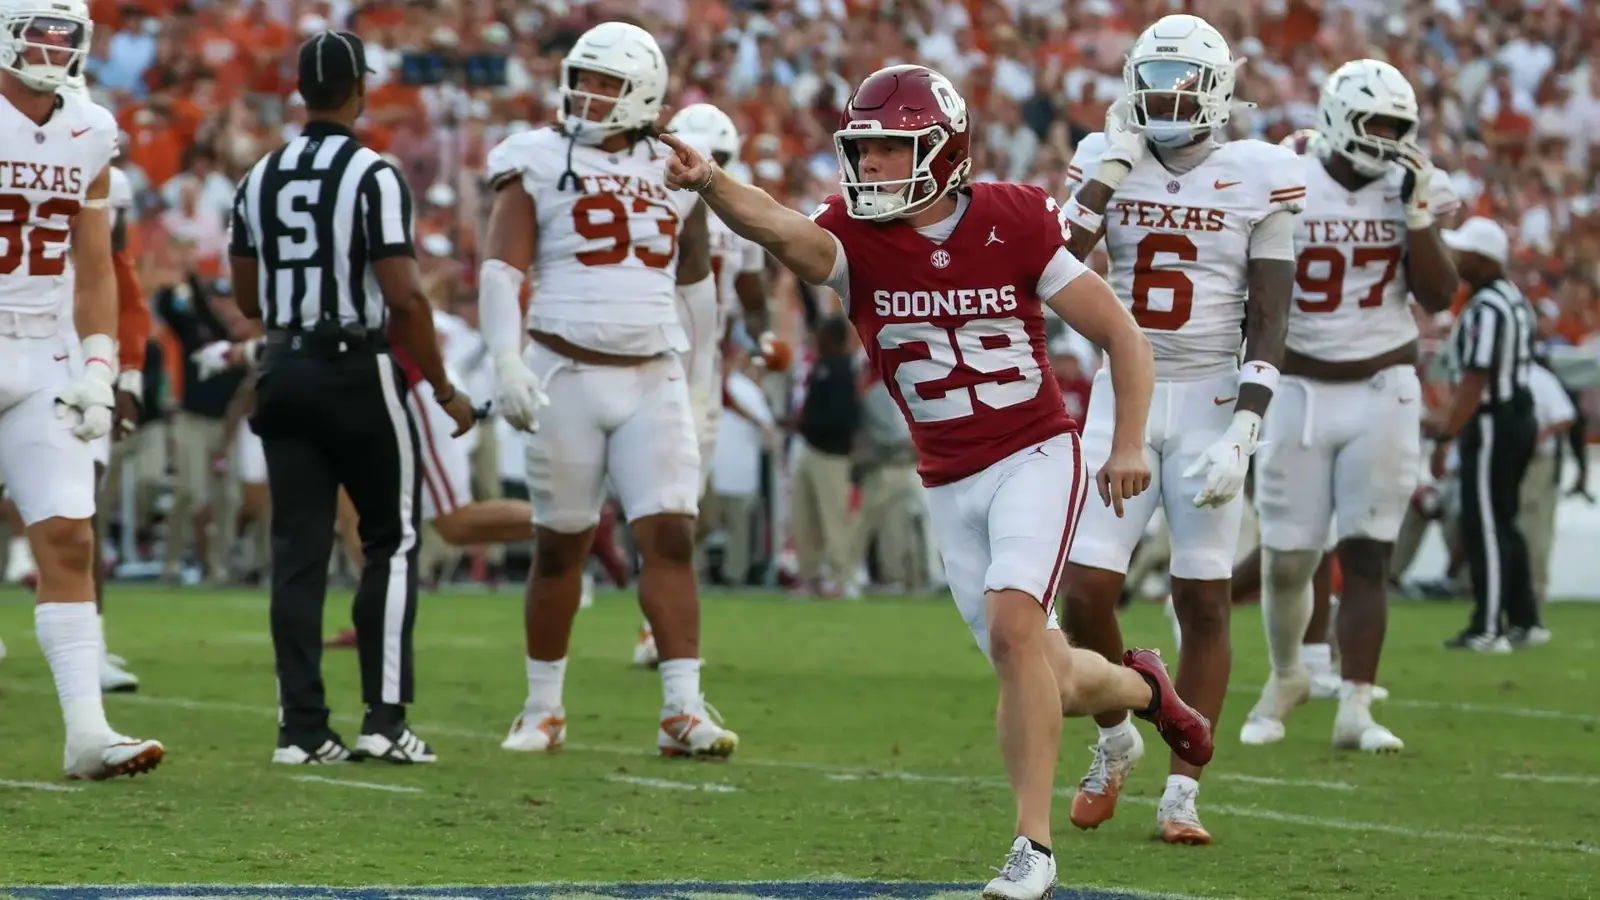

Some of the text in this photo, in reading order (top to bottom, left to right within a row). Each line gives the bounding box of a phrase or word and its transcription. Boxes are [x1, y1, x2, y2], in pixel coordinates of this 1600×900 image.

[276, 179, 322, 261] S
[572, 192, 679, 269] 93
[1116, 201, 1226, 232] TEXAS
[1304, 219, 1397, 243] TEXAS
[931, 250, 950, 268] SEC
[1131, 232, 1199, 331] 6
[1295, 246, 1403, 313] 97
[873, 285, 1018, 317] SOONERS
[876, 316, 1043, 423] 29
